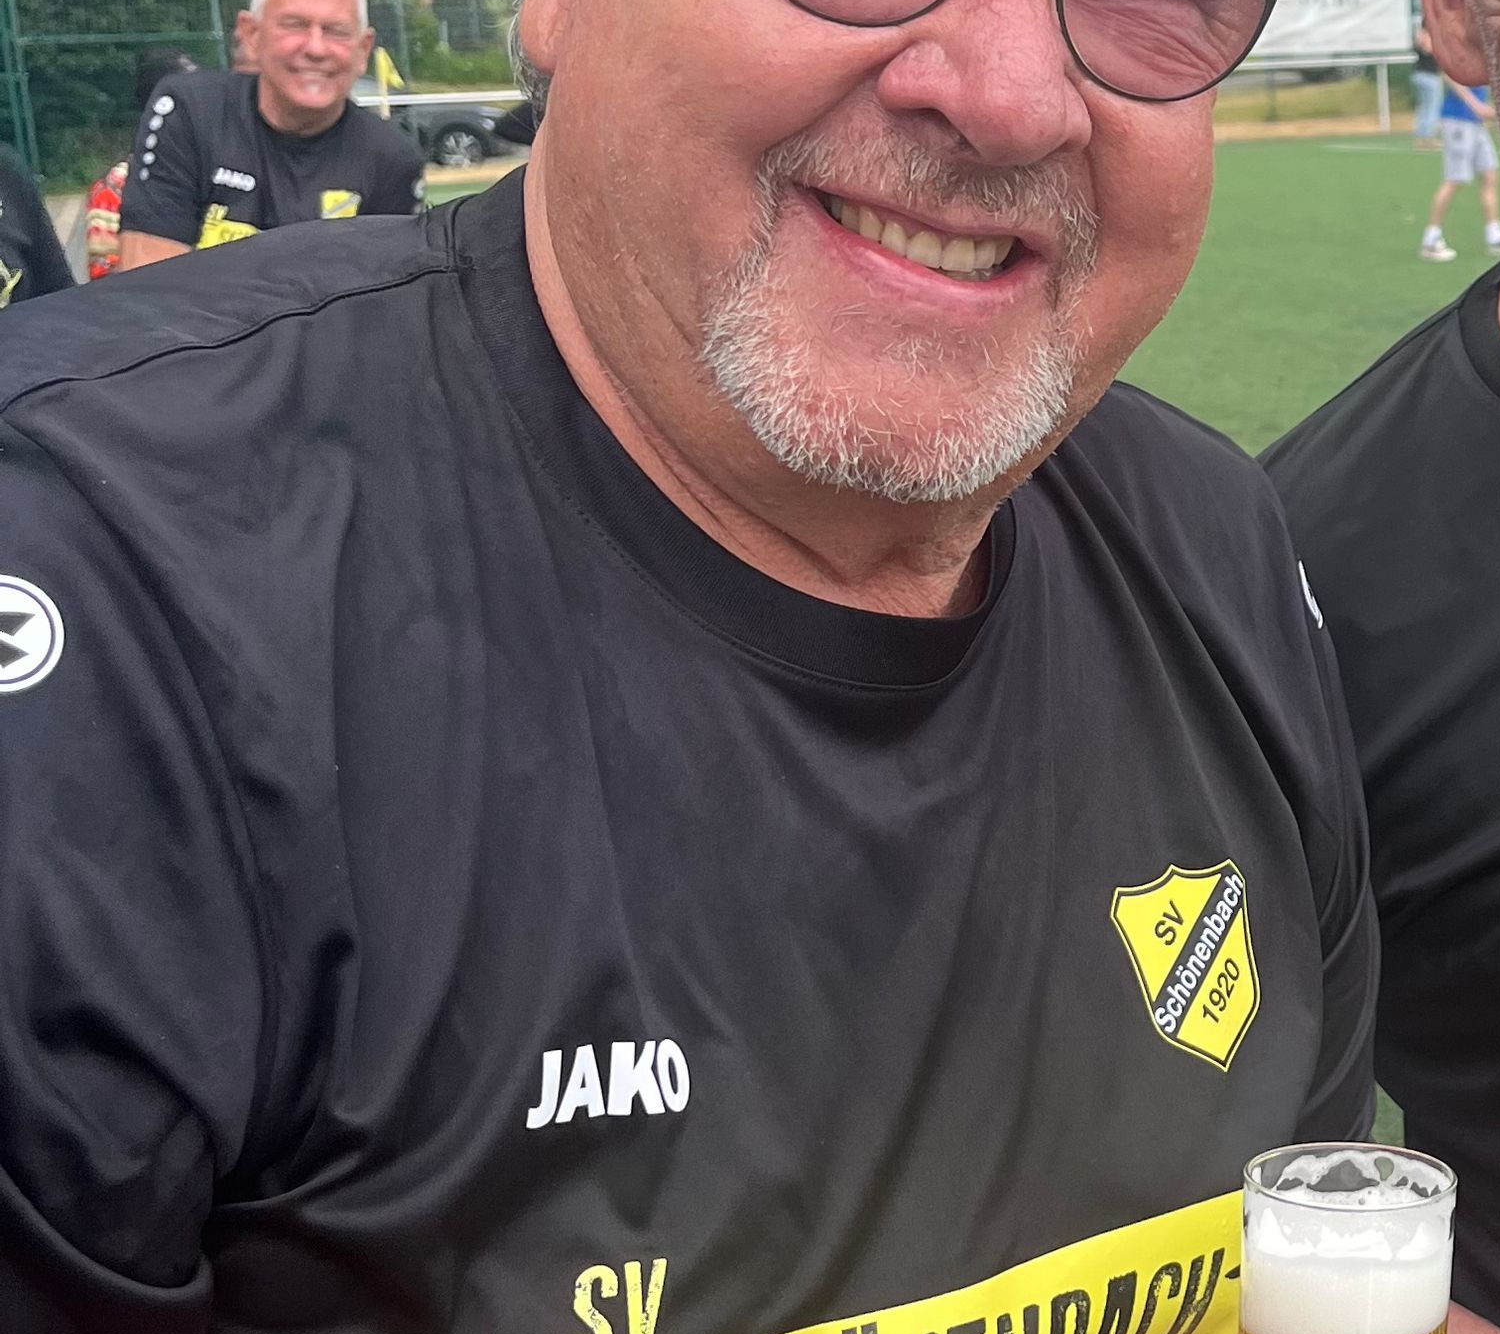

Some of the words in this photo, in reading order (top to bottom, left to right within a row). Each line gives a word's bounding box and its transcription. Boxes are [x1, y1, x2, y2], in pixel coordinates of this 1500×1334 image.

[1154, 900, 1185, 947] SV
[1154, 873, 1245, 1034] Schönenbach
[1202, 957, 1241, 1024] 1920
[526, 1039, 690, 1129] JAKO
